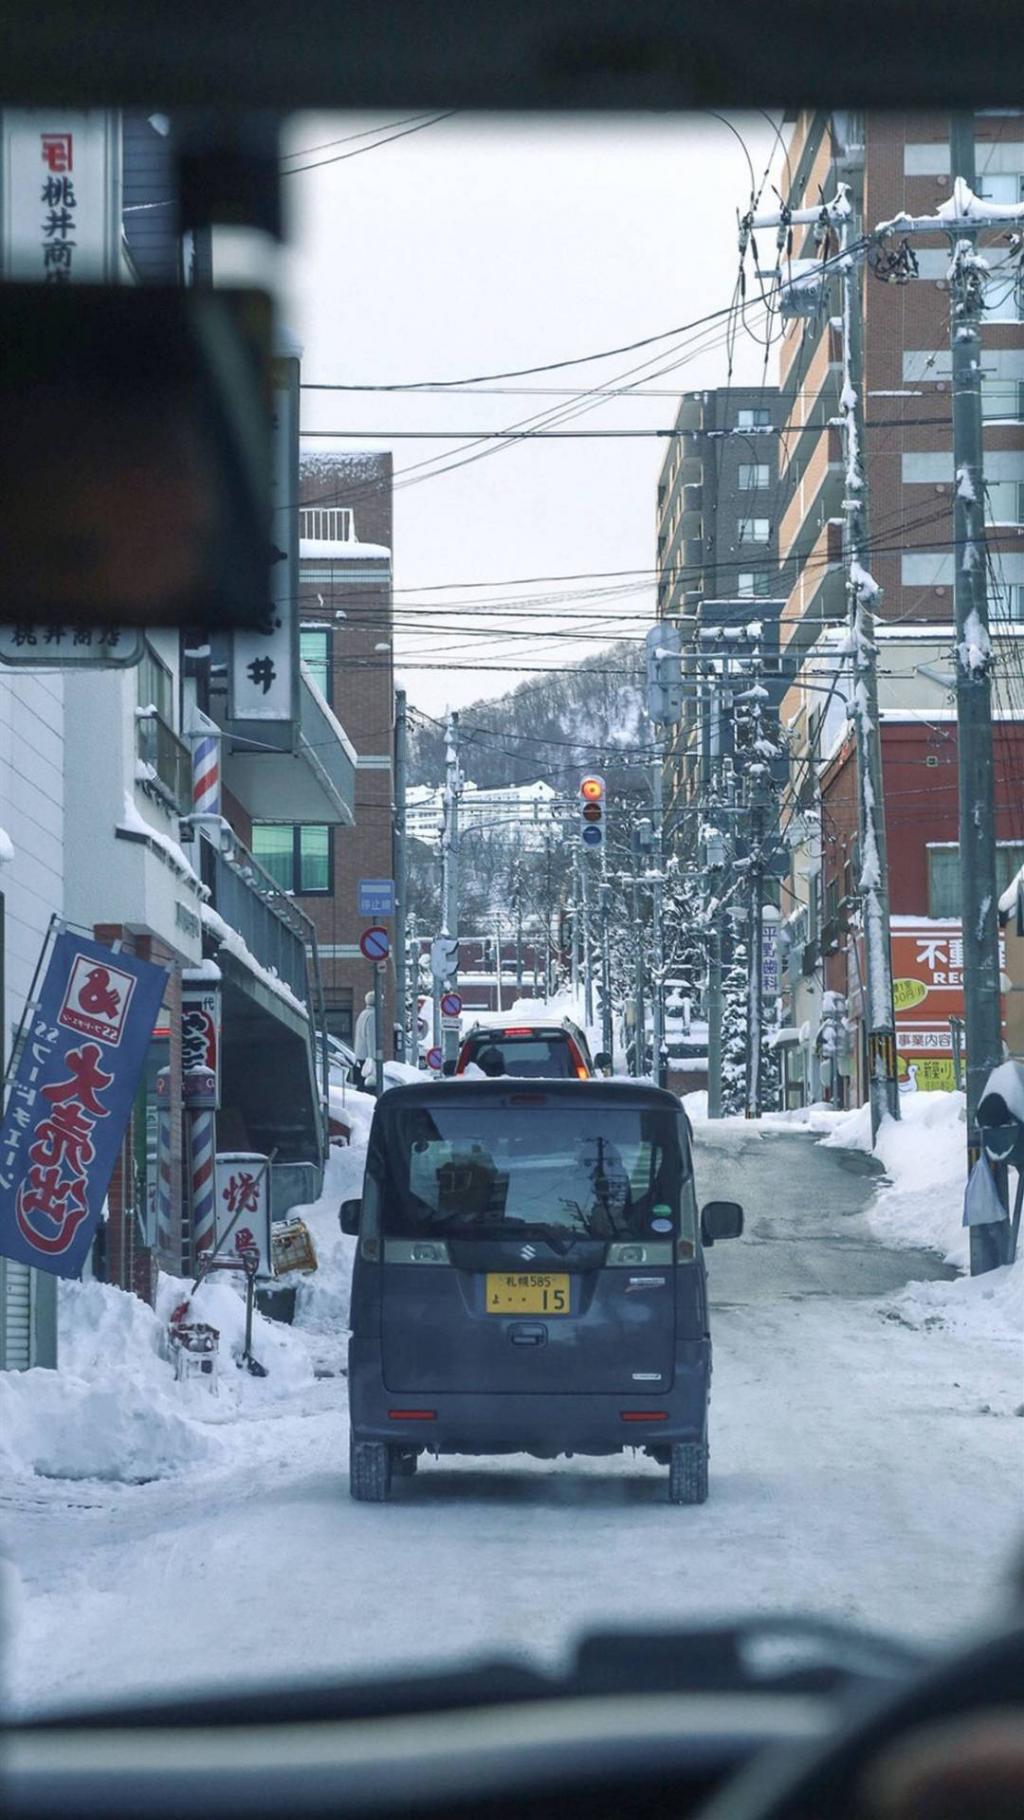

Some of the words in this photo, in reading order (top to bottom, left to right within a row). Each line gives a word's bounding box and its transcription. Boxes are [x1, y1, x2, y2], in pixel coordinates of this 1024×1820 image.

[762, 926, 778, 991] 平野歯科
[933, 972, 964, 984] RE
